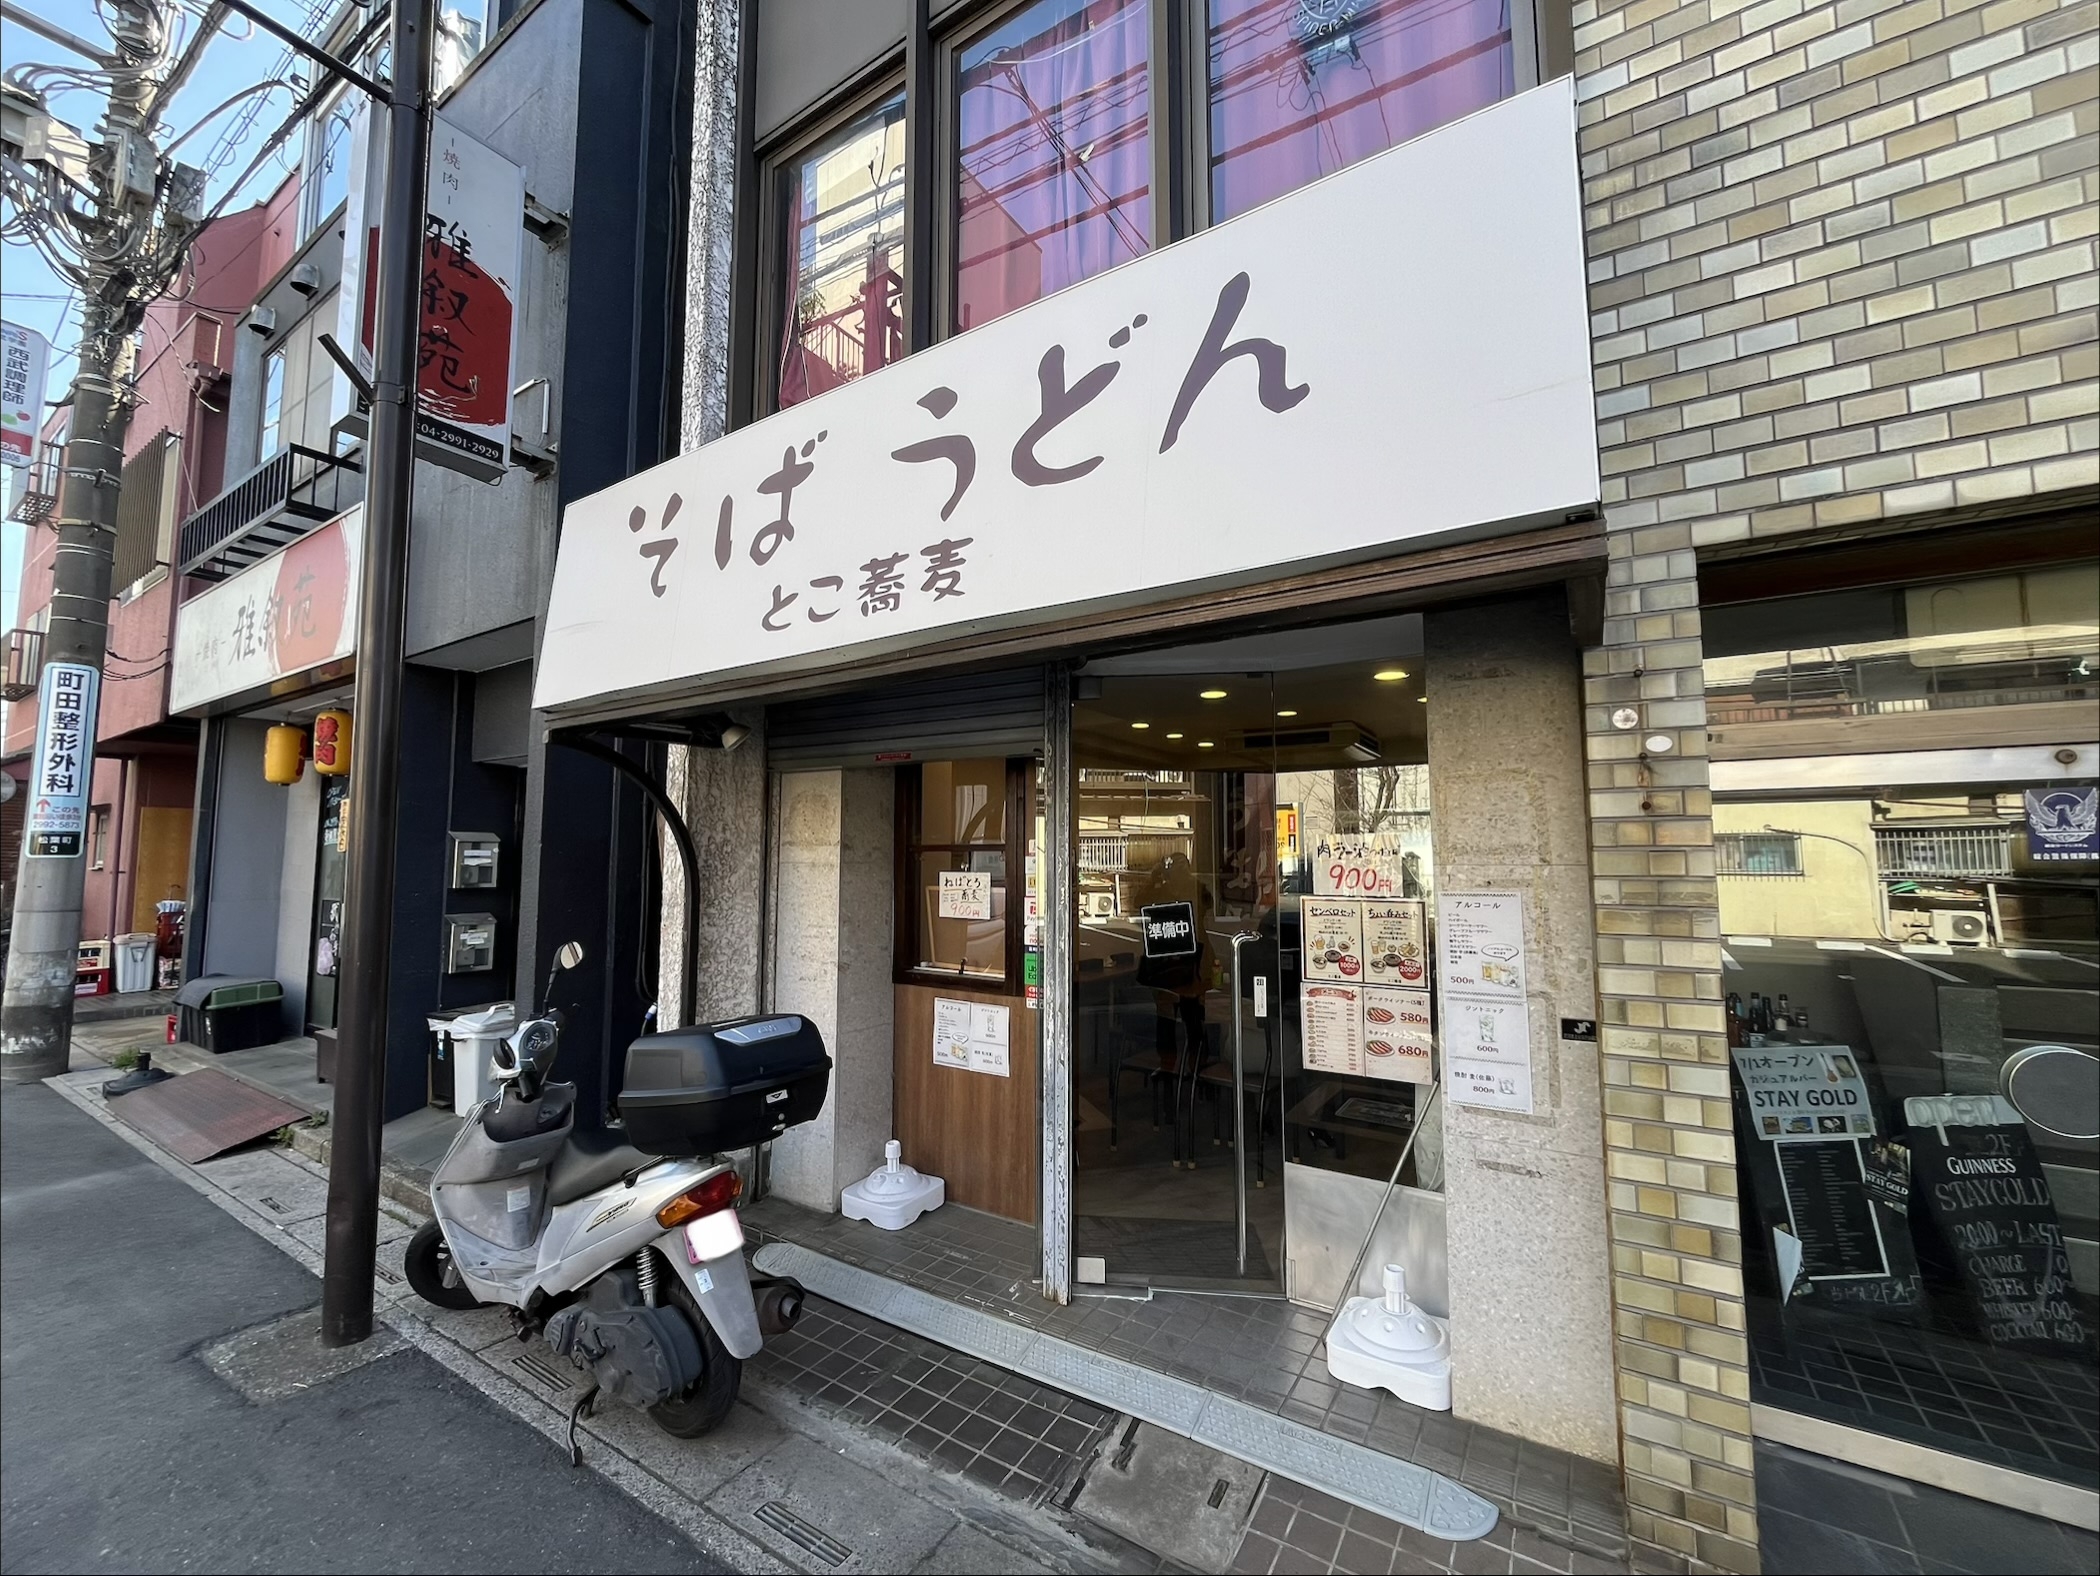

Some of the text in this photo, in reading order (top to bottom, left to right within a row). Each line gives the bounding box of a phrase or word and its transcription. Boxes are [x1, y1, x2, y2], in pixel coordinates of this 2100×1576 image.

[2, 345, 30, 405] 西武調理師
[629, 270, 1310, 599] そば うどん
[760, 536, 975, 633] とこ蕎麦
[46, 671, 85, 793] 町田整形外科
[52, 806, 80, 814] この先
[33, 821, 80, 829] 2992-5873
[50, 845, 58, 853] 3
[1329, 864, 1392, 893] 900円
[950, 902, 981, 917] 900円
[1310, 906, 1356, 917] センベロセット
[1456, 901, 1501, 909] アルコール
[1148, 920, 1189, 940] 準備中
[1450, 976, 1474, 984] 500円
[1465, 1005, 1504, 1014] ジントニック
[1400, 1012, 1428, 1023] 580円
[1398, 1045, 1428, 1057] 680円
[1477, 1045, 1499, 1053] 600円
[1740, 1053, 1814, 1069] 7/1オープン
[1750, 1074, 1817, 1084] カジュアルバー
[1472, 1085, 1495, 1094] 800円
[1754, 1089, 1857, 1107] STAY GOLD
[1907, 1097, 1999, 1146] open
[1946, 1157, 2016, 1175] GUINNESS
[1866, 1173, 1885, 1187] STAY
[1885, 1181, 1909, 1196] GOLD
[1968, 1254, 2027, 1275] CHARGE
[1978, 1278, 2029, 1298] BEER
